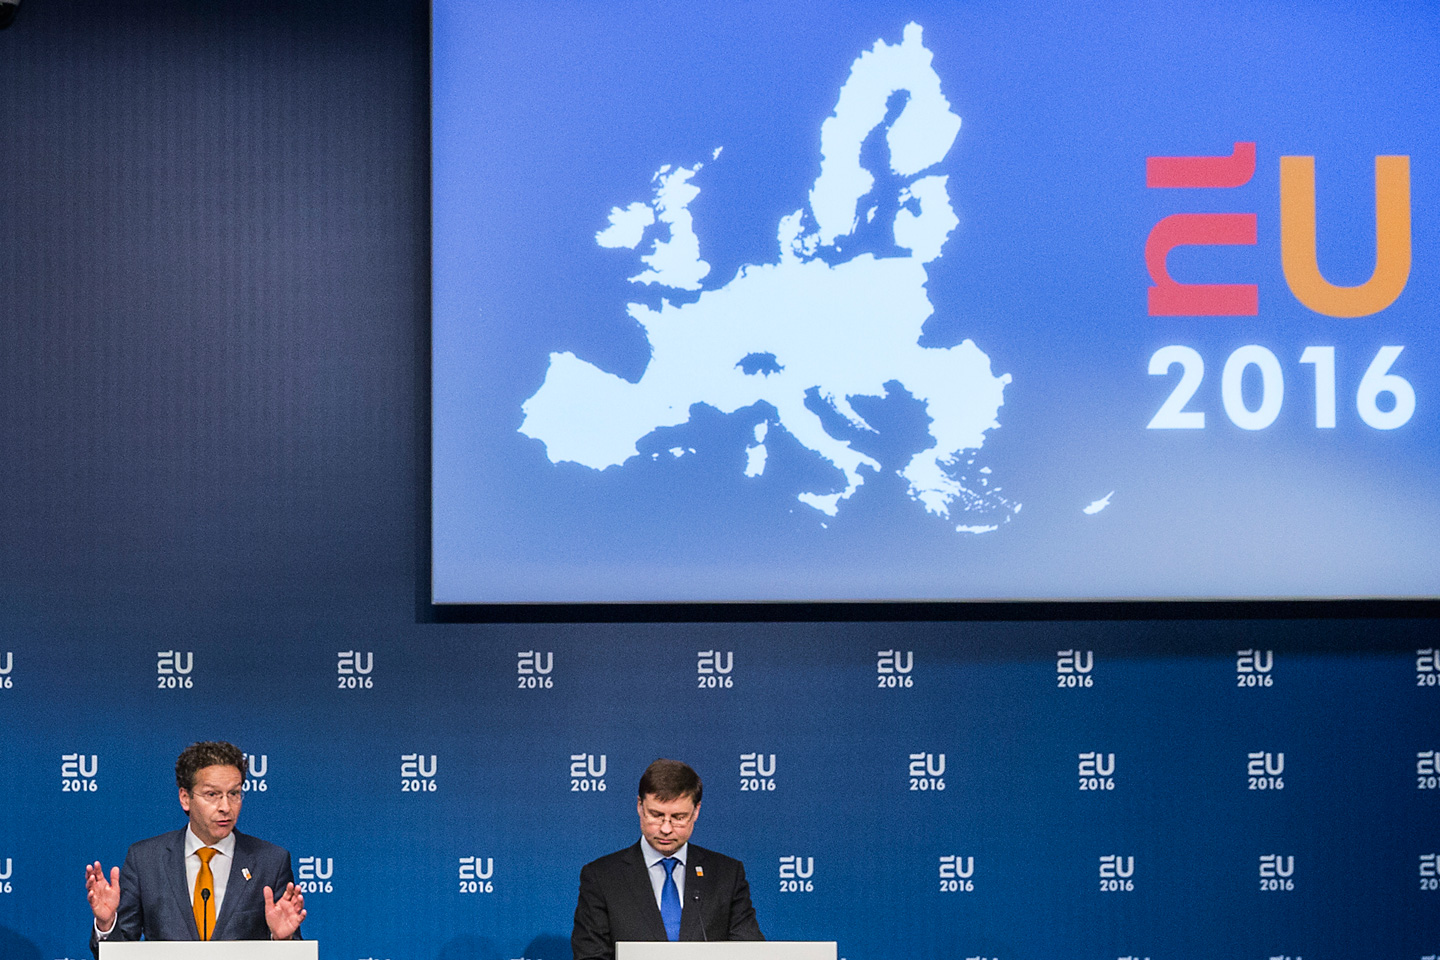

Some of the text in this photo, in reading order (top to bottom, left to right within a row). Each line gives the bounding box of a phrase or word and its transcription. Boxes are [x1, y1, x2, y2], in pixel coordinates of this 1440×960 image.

[1146, 345, 1417, 431] 2016
[157, 676, 194, 689] 2016
[337, 676, 374, 689] 2016
[517, 676, 554, 689] 2016
[697, 675, 734, 689] 2016
[877, 675, 914, 689] 2016
[1056, 674, 1094, 688] 2016
[1236, 674, 1274, 688] 2016
[61, 779, 98, 793] 2016
[400, 779, 438, 792] 2016
[570, 778, 607, 792] 2016
[739, 778, 777, 792] 2016
[909, 777, 946, 791] 2016
[1078, 777, 1116, 791] 2016
[1247, 776, 1285, 791] 2016
[299, 880, 334, 894] 2016
[458, 880, 494, 894] 2016
[779, 879, 814, 893] 2016
[939, 879, 975, 892] 2016
[1099, 879, 1135, 892] 2016
[1259, 878, 1295, 891] 2016
